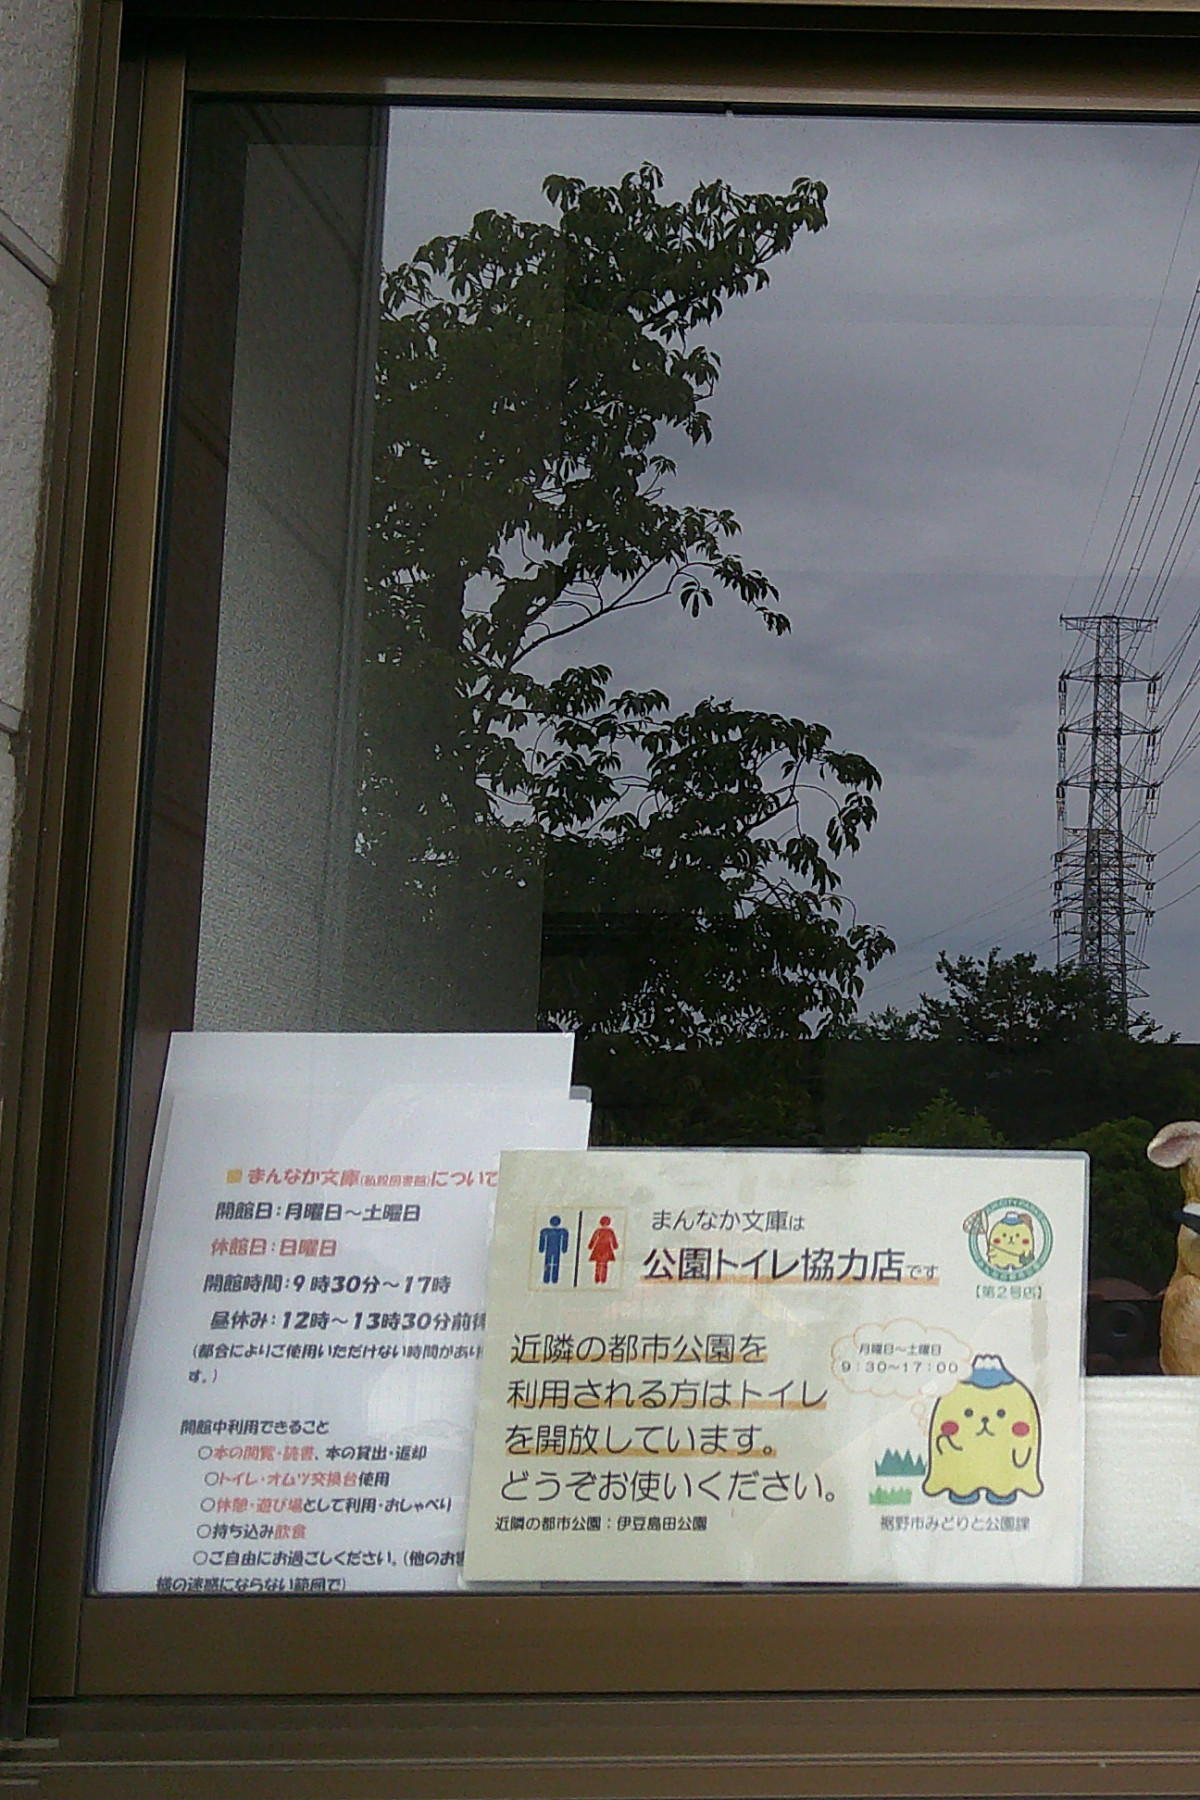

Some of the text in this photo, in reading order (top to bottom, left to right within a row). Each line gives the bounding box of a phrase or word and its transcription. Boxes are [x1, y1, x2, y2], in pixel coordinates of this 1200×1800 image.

[651, 1209, 805, 1233] まんなか文庫は
[643, 1247, 938, 1281] 公園トイレ協力店です
[193, 1342, 484, 1360] (都合によりご使用いただけない時間があり
[510, 1333, 767, 1364] 近隣の都市公園を
[507, 1379, 828, 1409] 利用される方はトイレ
[180, 1419, 330, 1436] 開館中利用できること
[505, 1424, 773, 1456] を開放しています。
[501, 1470, 835, 1503] どうぞお使いください。
